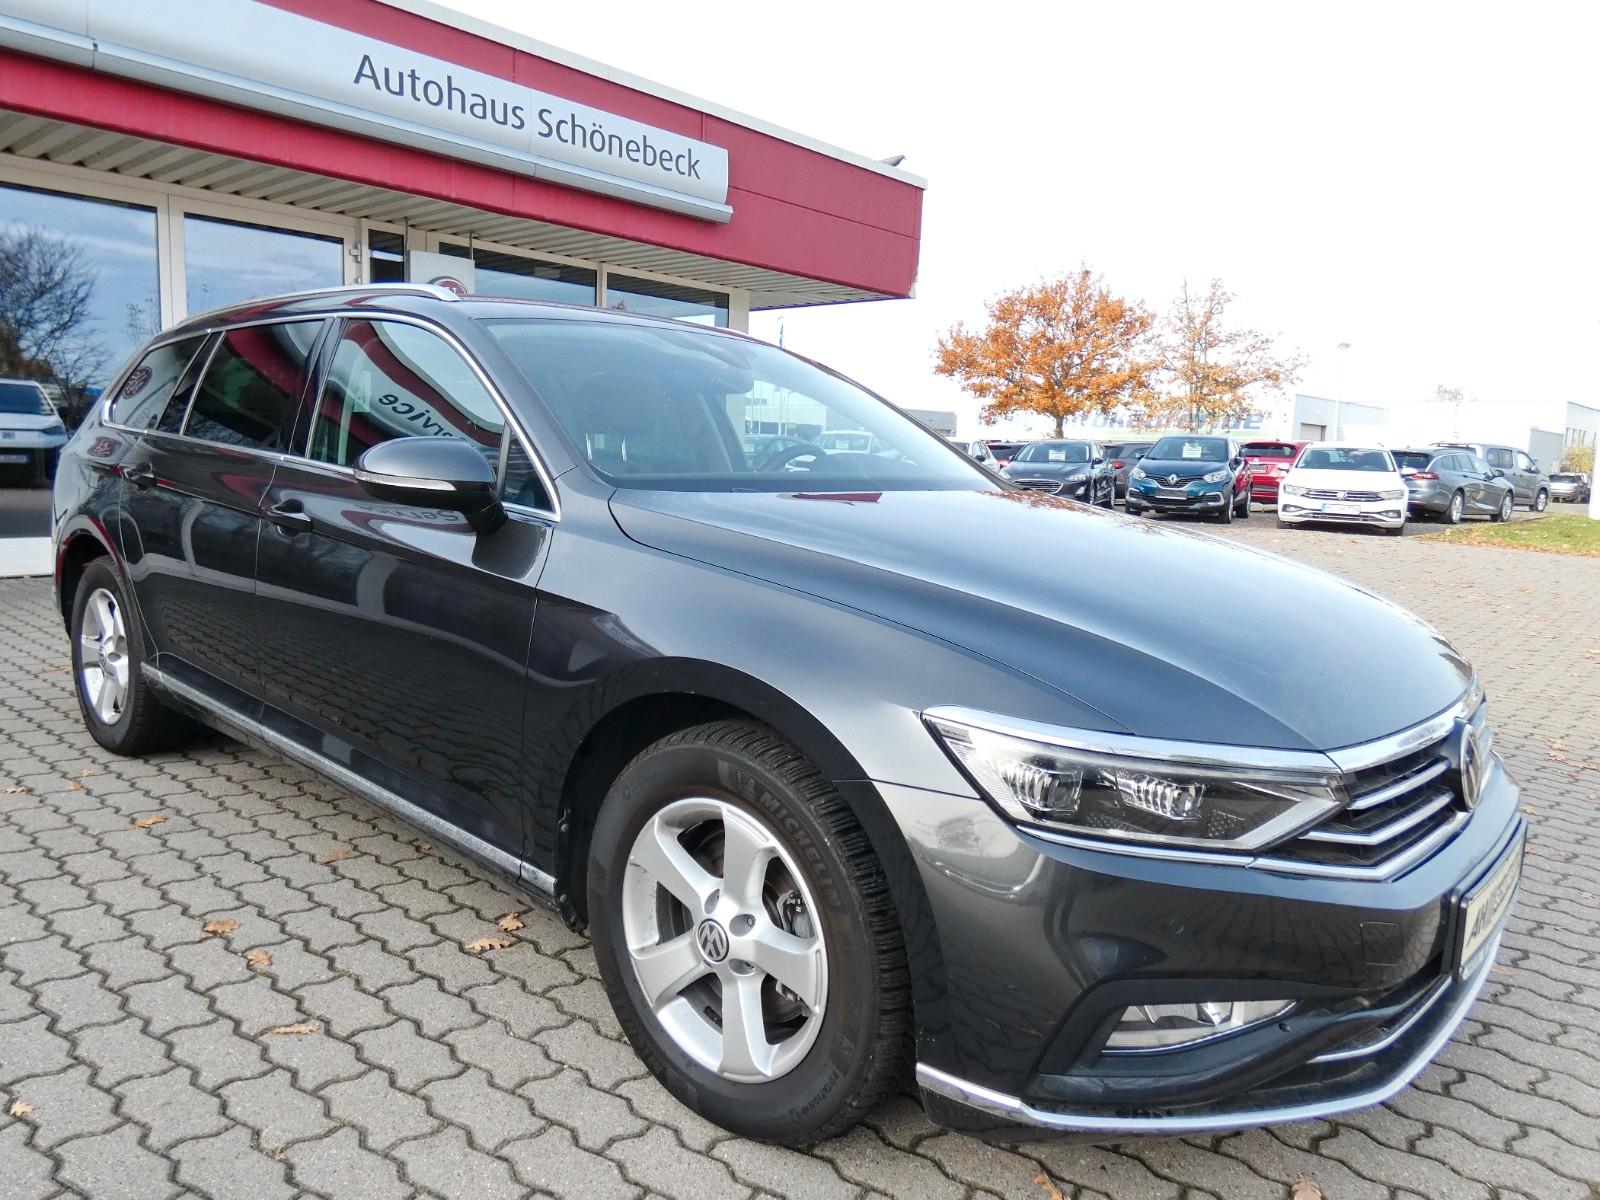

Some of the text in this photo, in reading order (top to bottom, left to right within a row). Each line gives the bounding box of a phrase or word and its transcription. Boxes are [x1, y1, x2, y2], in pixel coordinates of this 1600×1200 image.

[353, 54, 702, 181] Autohaus Schönebeck
[759, 791, 842, 907] MICHELIN
